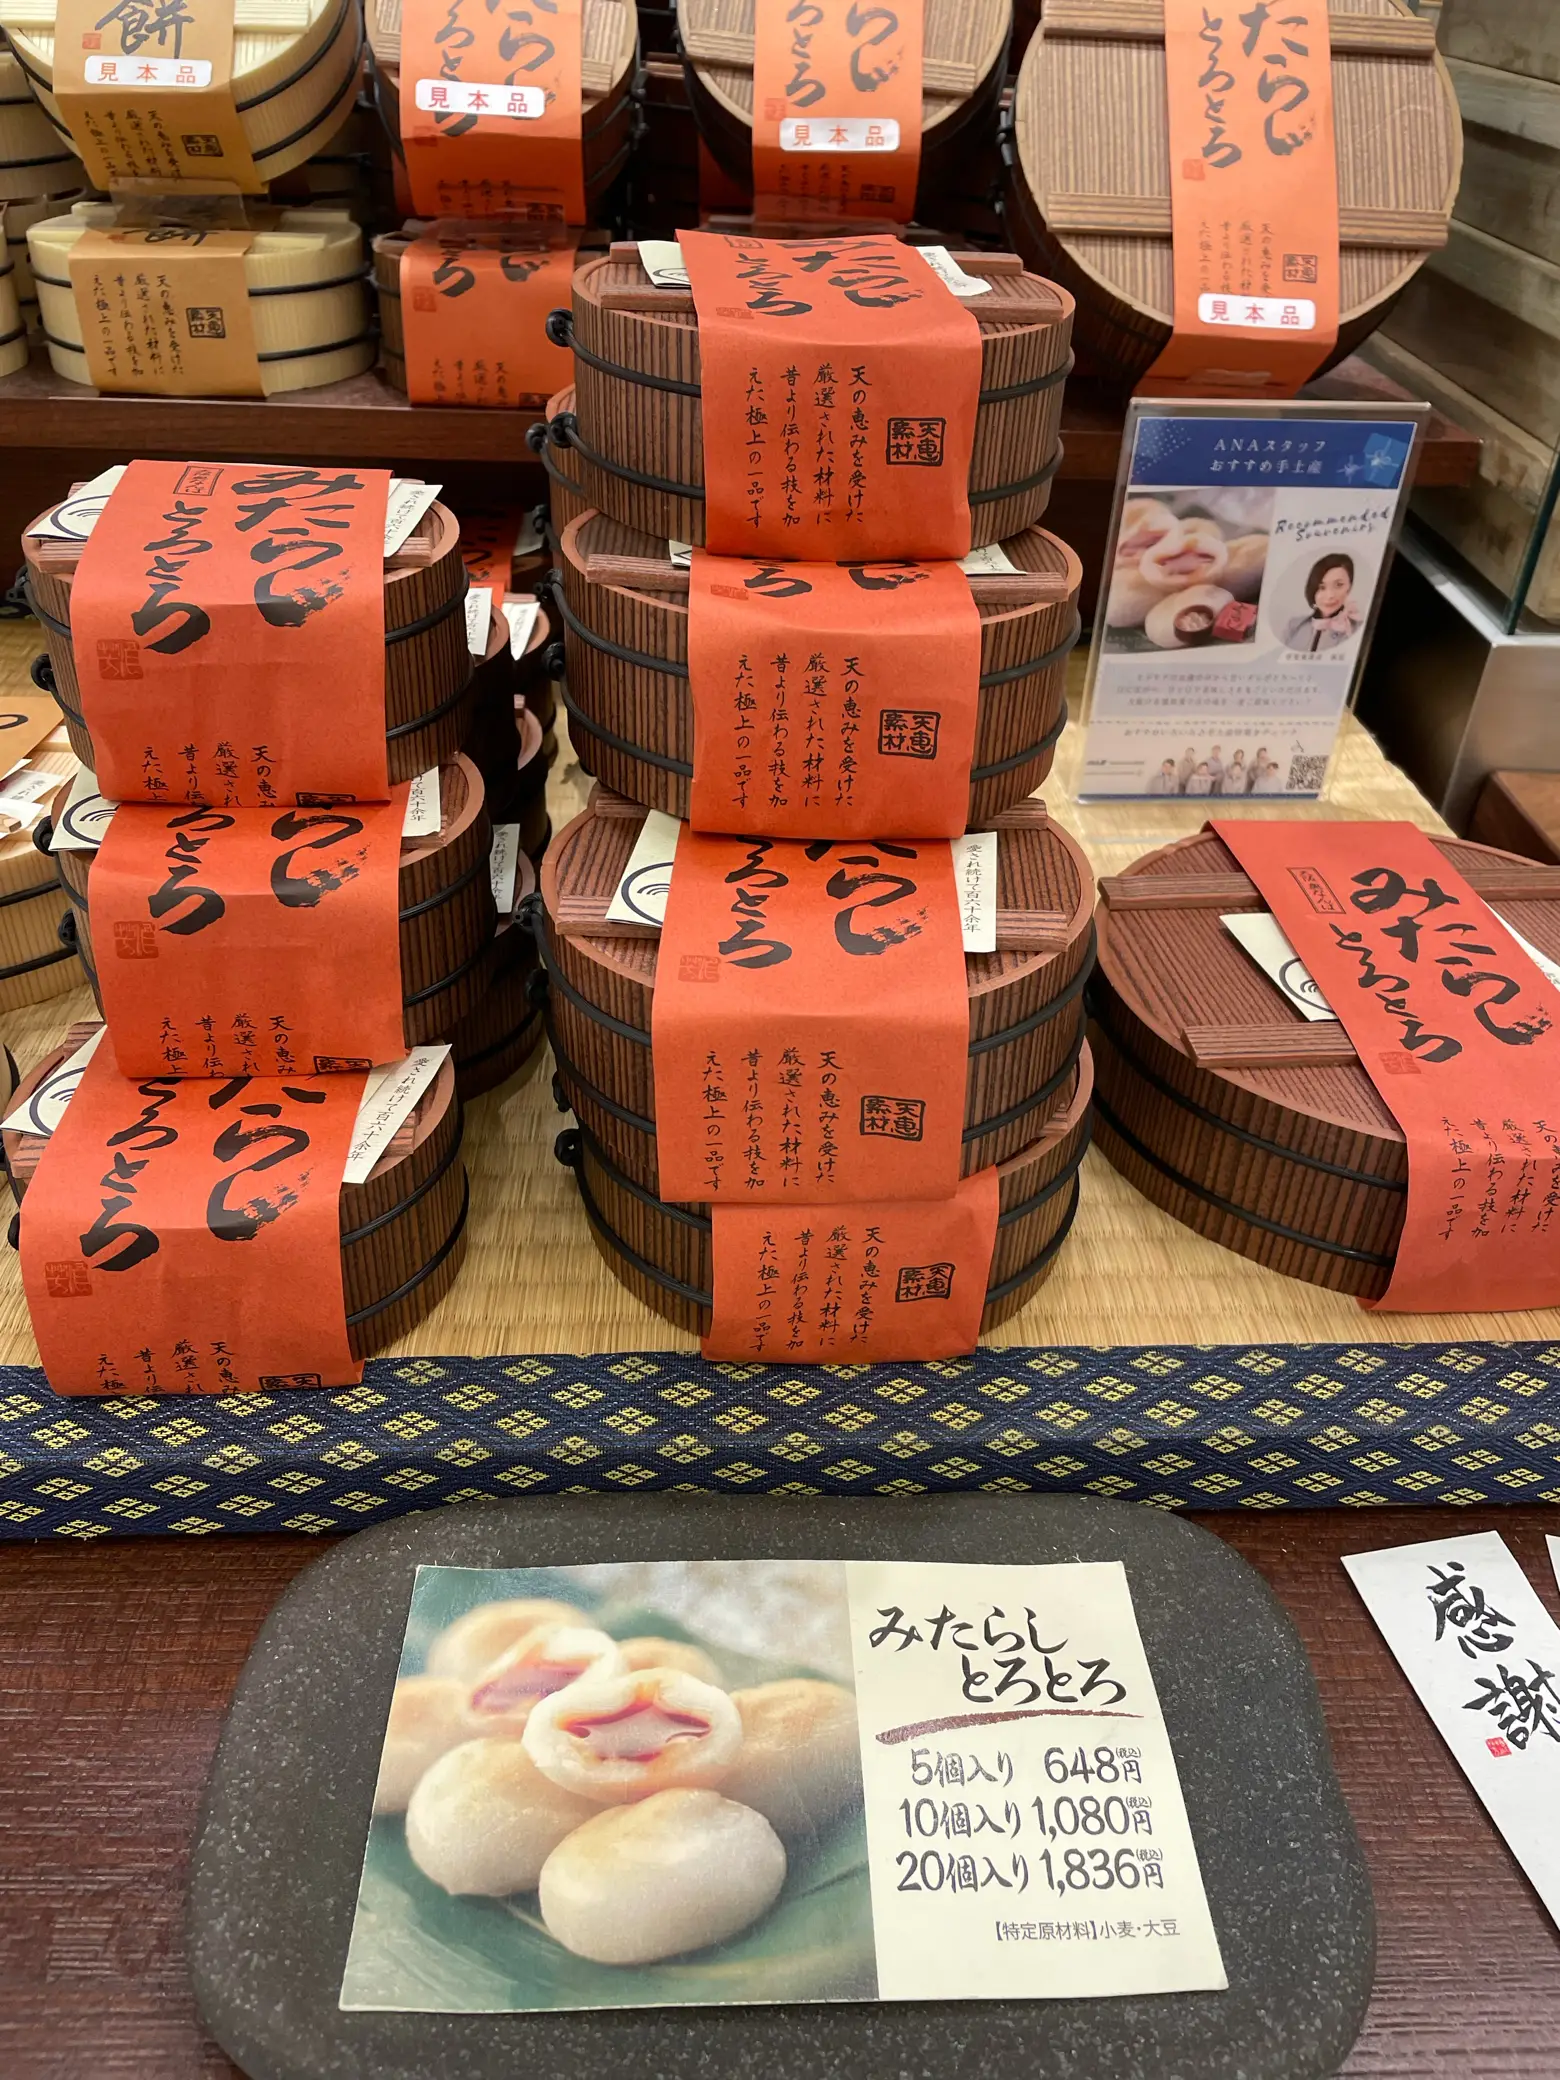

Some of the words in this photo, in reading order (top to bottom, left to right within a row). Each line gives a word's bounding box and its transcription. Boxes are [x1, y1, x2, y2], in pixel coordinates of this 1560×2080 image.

[98, 62, 196, 84] 見本品
[428, 86, 528, 114] 見本品
[793, 125, 885, 146] 見本品
[1210, 301, 1300, 325] 見本品
[746, 367, 768, 528] えた極上の一品です
[780, 365, 801, 527] 昔より伝わる技を加
[813, 363, 838, 524] 厳選された材料に
[846, 365, 872, 523] 天の恵みを受けた
[1209, 459, 1324, 474] おすすめ手土産
[1214, 438, 1326, 453] ANAスタッフ
[178, 744, 205, 806] 昔より伝
[732, 654, 757, 809] えた極上の一品です
[767, 653, 791, 807] 昔より伝わる技を加
[802, 653, 830, 807] 厳選された材料に
[835, 656, 865, 807] 天の恵みを受けた
[963, 844, 983, 933] 愛され続けて百六十余年
[347, 1056, 430, 1161] 愛され続けて百六十余年
[702, 1051, 728, 1191] えた極上の一品です
[741, 1051, 765, 1188] 昔より伝わる技を加
[777, 1048, 806, 1187] 厳選された材料に
[815, 1051, 844, 1184] 天の恵みを受けた
[1438, 1117, 1473, 1240] えた極上の一品です
[1470, 1119, 1504, 1237] 昔より伝わる技を加
[1501, 1119, 1539, 1233] 厳選された材料に
[749, 1231, 780, 1352] えた極上の一品です
[786, 1229, 814, 1350] 昔より伝わる技を加
[819, 1224, 852, 1347] 厳選された材料に
[850, 1226, 886, 1344] 天の恵みを受けた
[868, 1603, 1069, 1655] みたらし
[960, 1652, 1128, 1706] とろとろ
[1425, 1560, 1560, 1751] 感謝
[899, 1797, 1022, 1840] 10個入り
[911, 1748, 1015, 1788] 5個入り
[896, 1849, 1030, 1894] 20個入り
